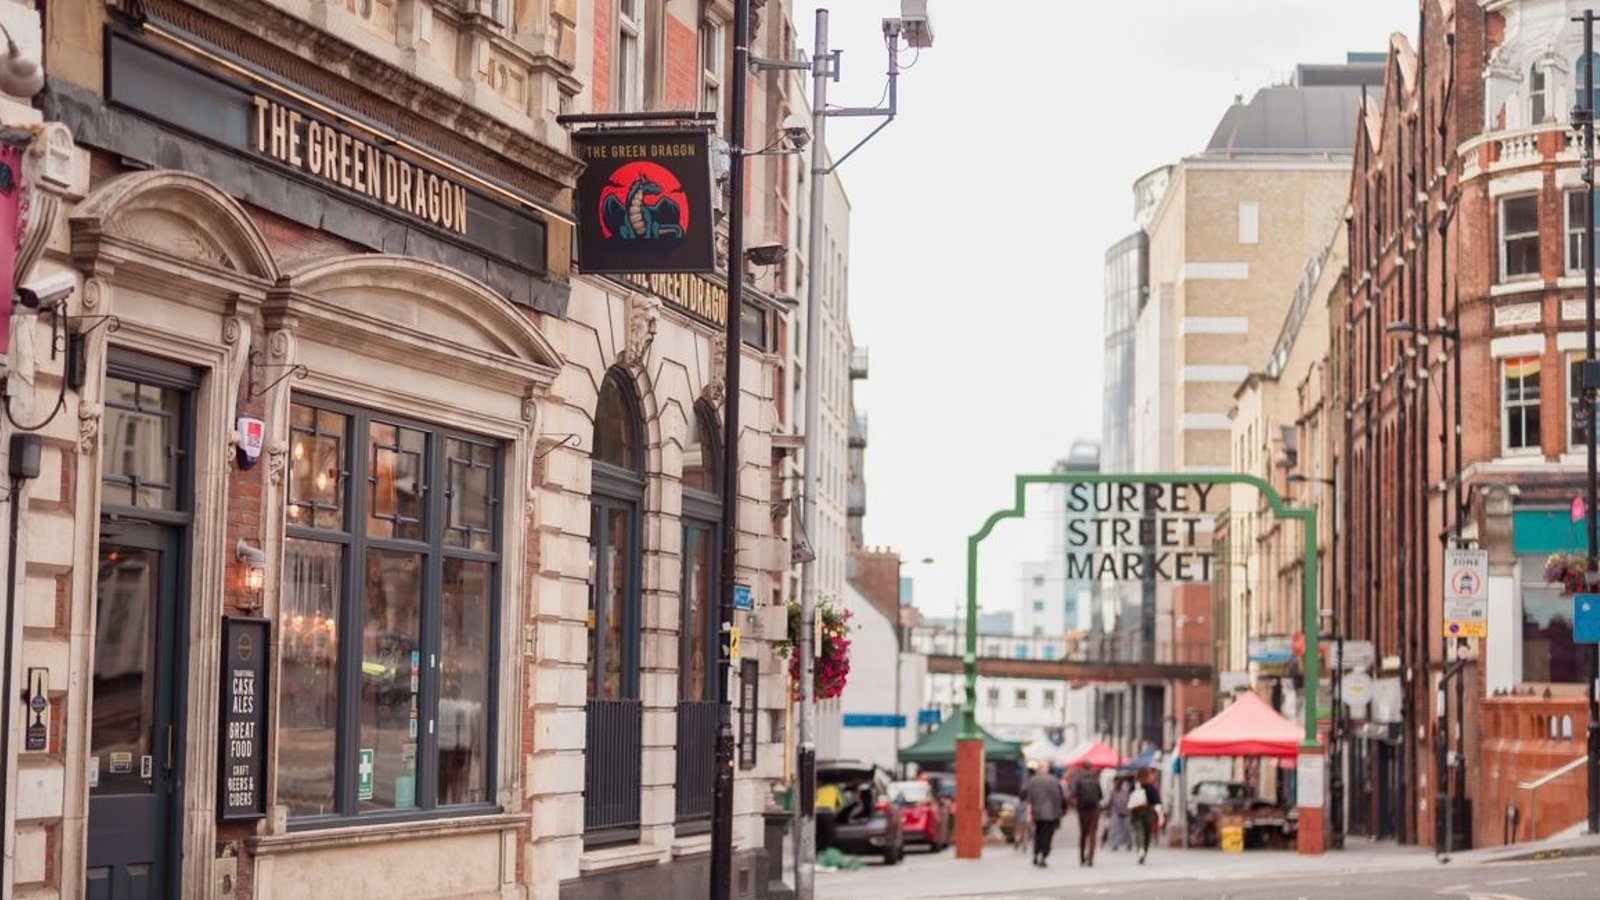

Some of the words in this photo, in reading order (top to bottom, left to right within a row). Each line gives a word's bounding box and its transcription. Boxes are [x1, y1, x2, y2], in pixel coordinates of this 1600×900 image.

[587, 146, 607, 158] THE
[611, 145, 647, 158] GREEN
[651, 144, 695, 156] DRAGON
[254, 95, 302, 167] THE
[308, 120, 381, 199] GREEN
[385, 153, 467, 235] DRAGON
[689, 273, 728, 326] DRAGO
[1066, 482, 1213, 512] SURREY
[1068, 518, 1202, 546] STREET
[1066, 553, 1216, 580] MARKET
[232, 678, 254, 695] CASK
[232, 696, 254, 713] ALES
[228, 721, 255, 739] GREAT
[231, 740, 252, 758] FOOD
[227, 777, 248, 792] BEERS
[249, 776, 255, 791] &
[228, 792, 252, 807] CIDERS
